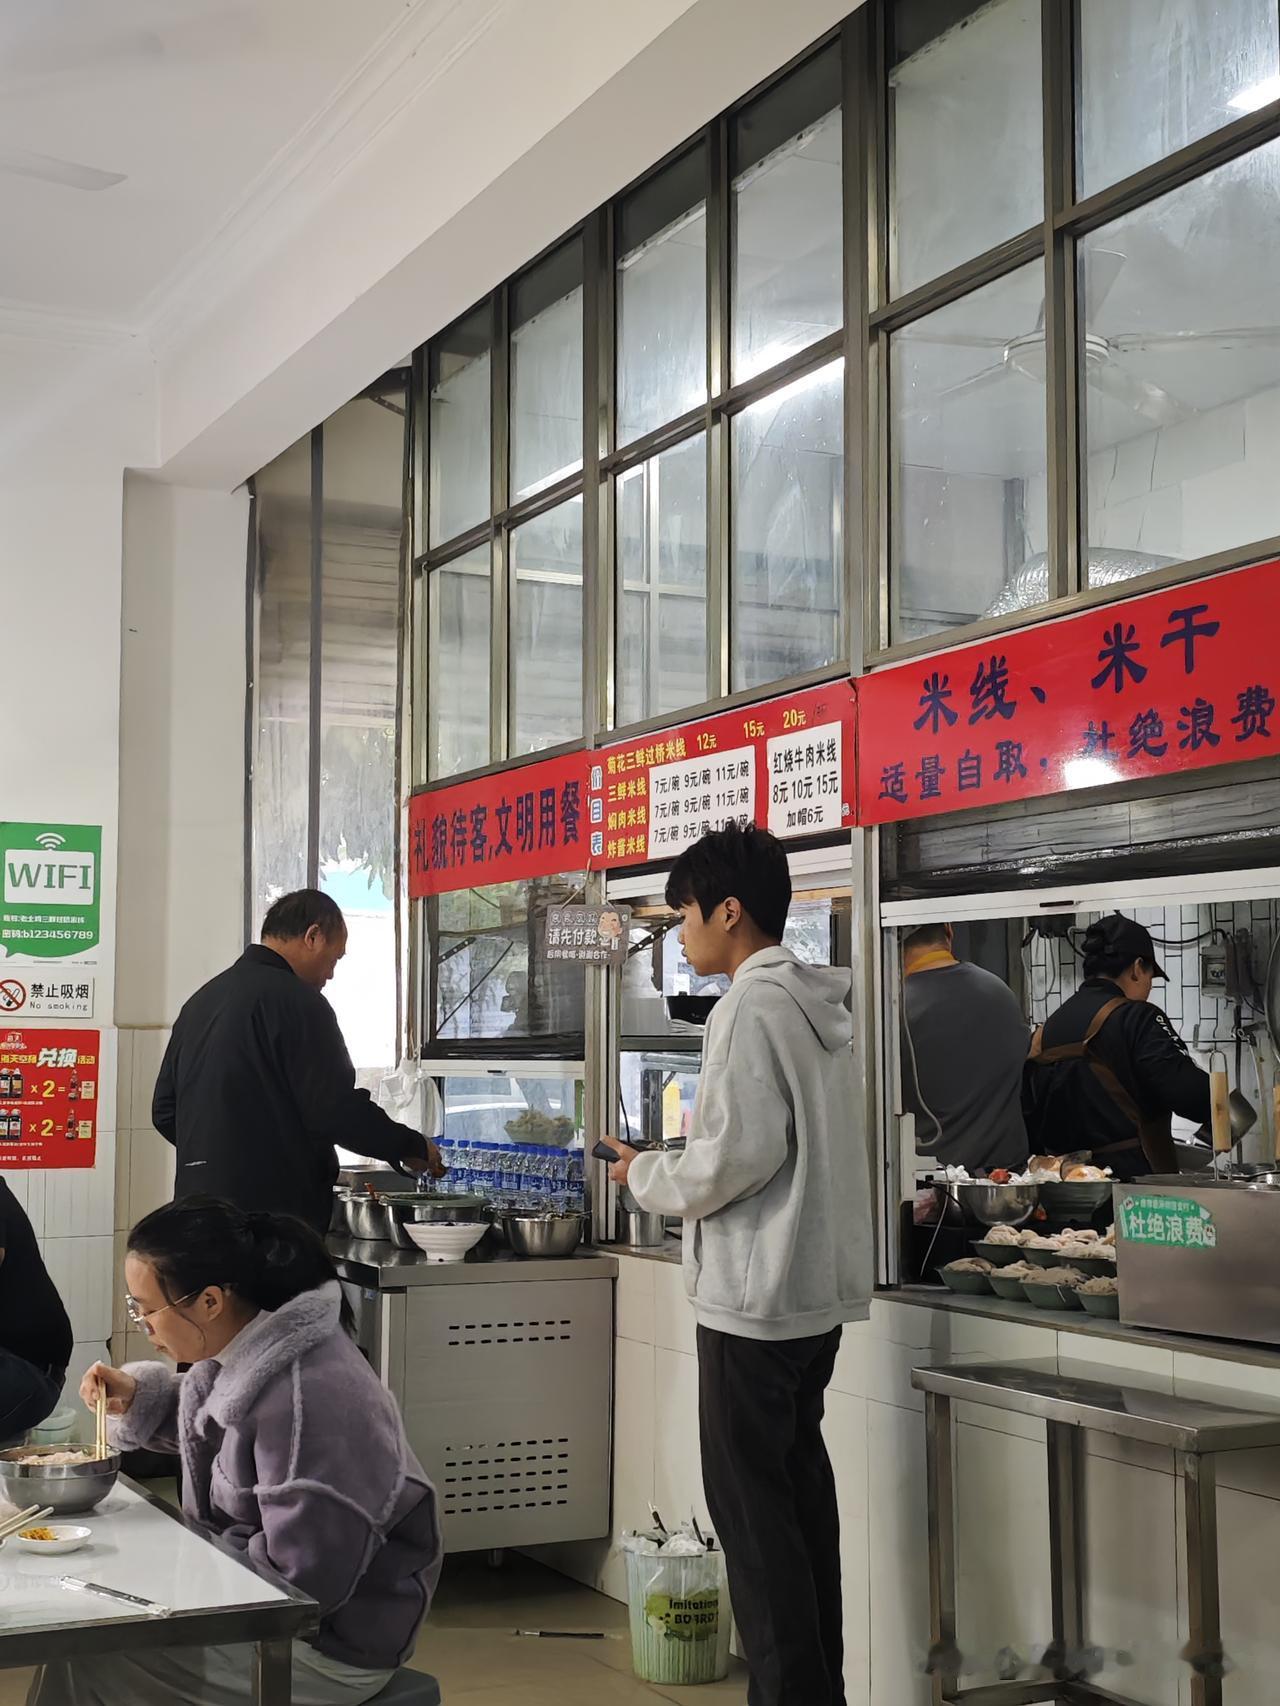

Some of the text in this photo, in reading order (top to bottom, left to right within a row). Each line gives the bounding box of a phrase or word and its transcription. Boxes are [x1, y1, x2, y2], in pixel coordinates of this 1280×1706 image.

[607, 737, 687, 775] 菊花三鲜过桥米线
[697, 732, 717, 751] 12元
[743, 720, 765, 739] 15元
[783, 709, 807, 729] 20元
[773, 738, 837, 775] 红烧牛肉米线
[608, 760, 749, 802] 三鲜米线 7元/碗 9元/碗 11元/碗
[772, 771, 838, 804] 8元 10元 15元
[607, 786, 749, 831] 焖肉米线 7元/碗 9元/碗 11元/碗
[786, 805, 824, 828] 加帽6元
[654, 825, 680, 843] 7元/碗
[8, 862, 92, 890] WIFI
[548, 928, 597, 946] 请先付款
[30, 983, 89, 999] 禁止吸烟
[47, 1003, 88, 1011] smoking
[1129, 1211, 1203, 1246] 杜绝浪费
